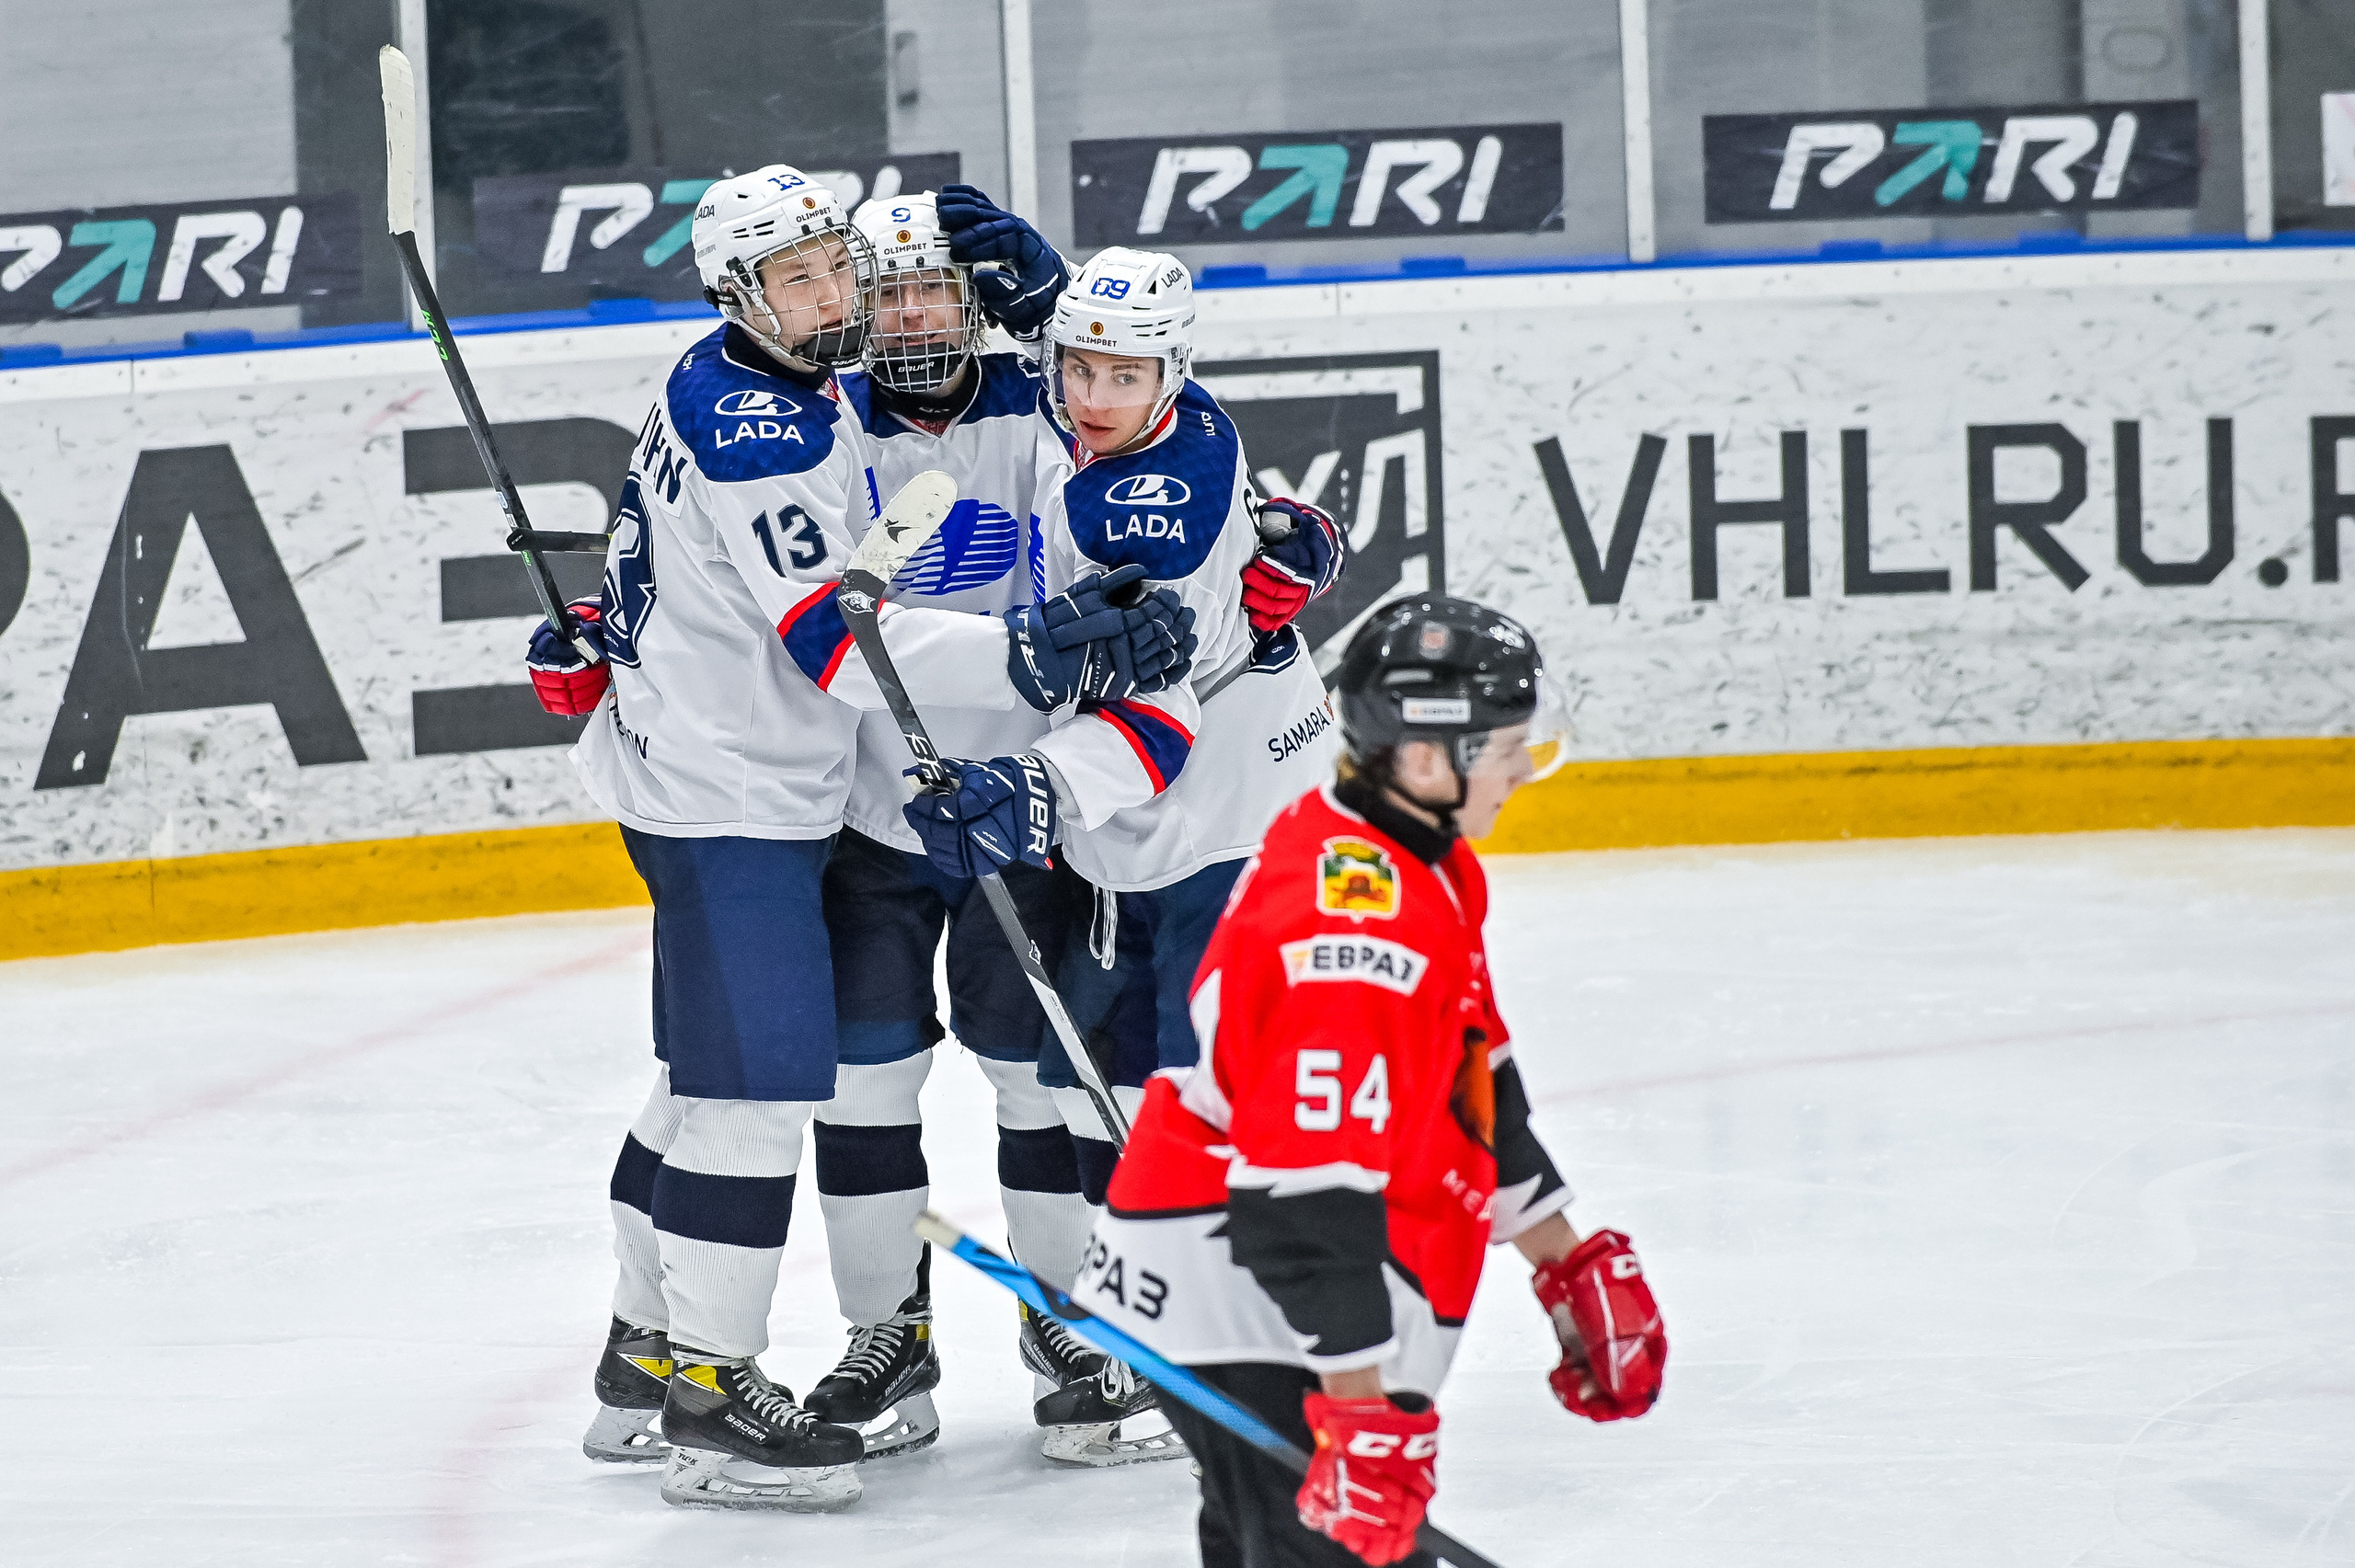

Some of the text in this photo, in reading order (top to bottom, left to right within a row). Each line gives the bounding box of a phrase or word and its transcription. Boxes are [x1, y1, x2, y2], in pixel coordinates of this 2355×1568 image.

[1769, 111, 2137, 210] PARI
[1137, 135, 1503, 235] PARI
[695, 204, 715, 222] LADA
[796, 206, 831, 223] OLIMPBET
[891, 207, 911, 223] 9
[884, 242, 927, 256] OLIMPBET
[1161, 267, 1184, 288] LADA
[1075, 335, 1118, 348] OLIMPBET
[715, 420, 805, 450] LADA
[751, 503, 829, 578] 13
[1105, 514, 1186, 544] LADA
[1268, 706, 1331, 762] SAMARA
[1294, 1048, 1393, 1135] 54
[1032, 1342, 1057, 1375] BAUER
[884, 1364, 913, 1398] BAUER
